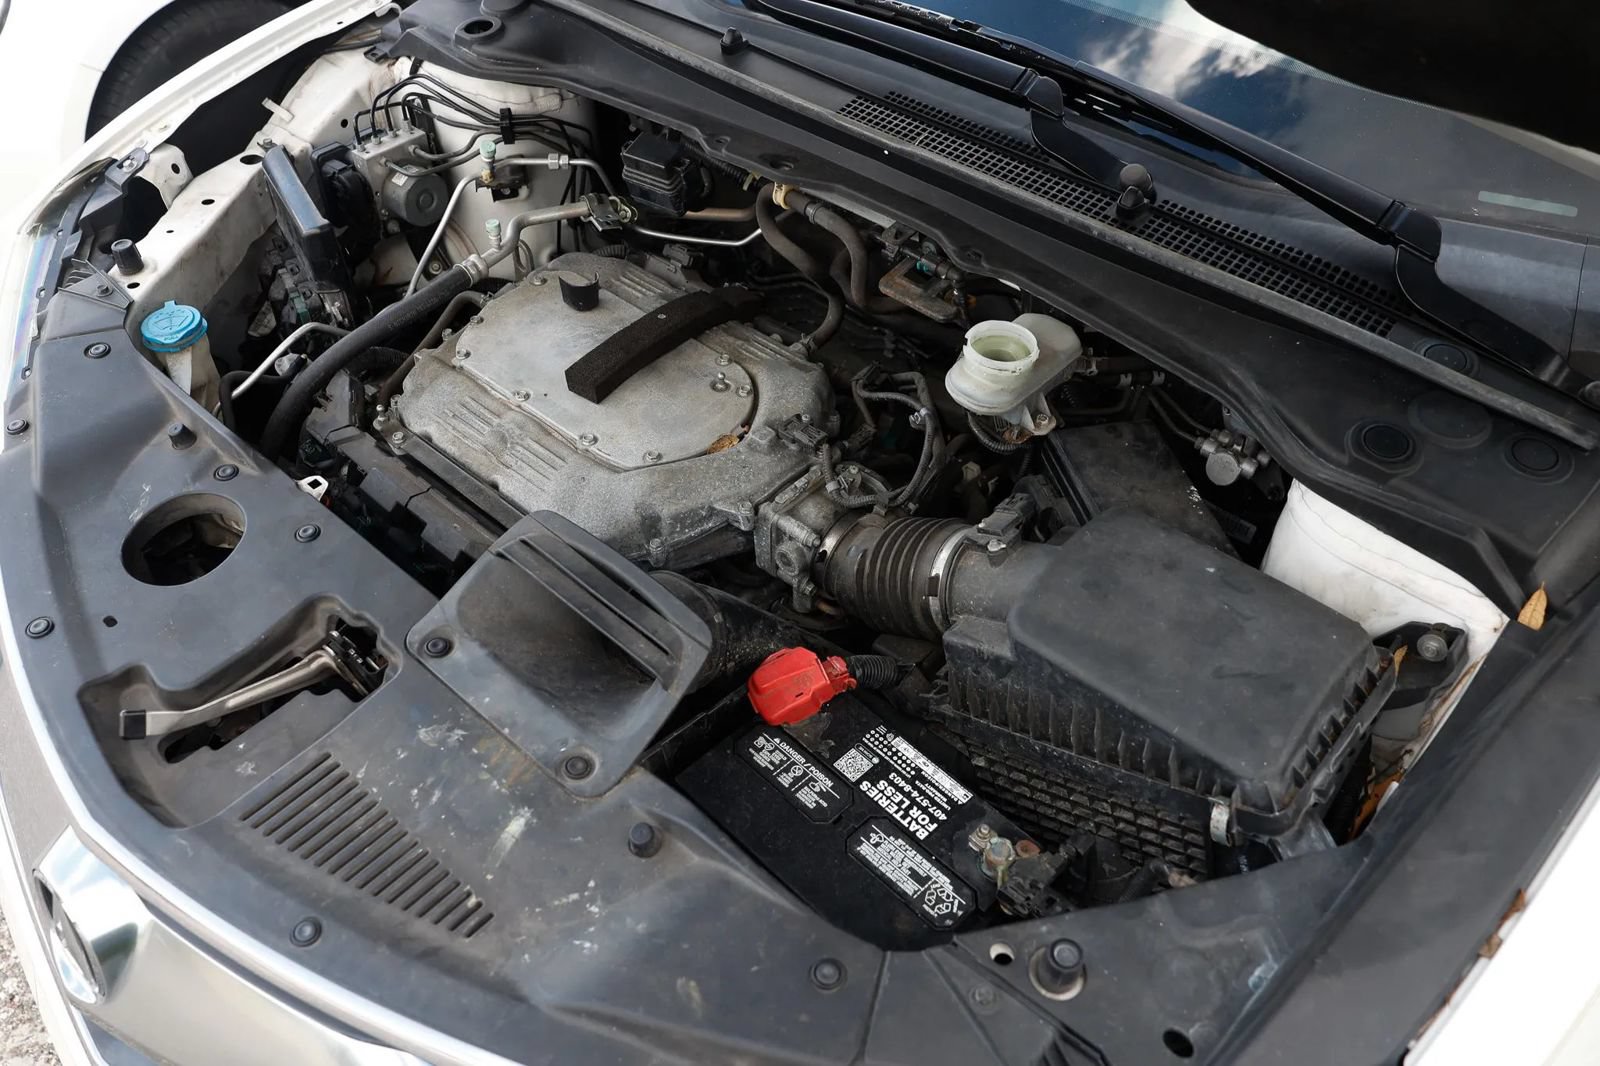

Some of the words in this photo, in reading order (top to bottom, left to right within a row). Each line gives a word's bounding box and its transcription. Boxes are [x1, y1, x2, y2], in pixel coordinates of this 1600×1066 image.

[778, 741, 807, 764] DANGER
[807, 765, 834, 787] POISON
[857, 779, 930, 840] BATTERIES
[874, 778, 911, 809] LESS
[886, 771, 949, 822] 407-574-8403
[907, 805, 939, 832] FOR
